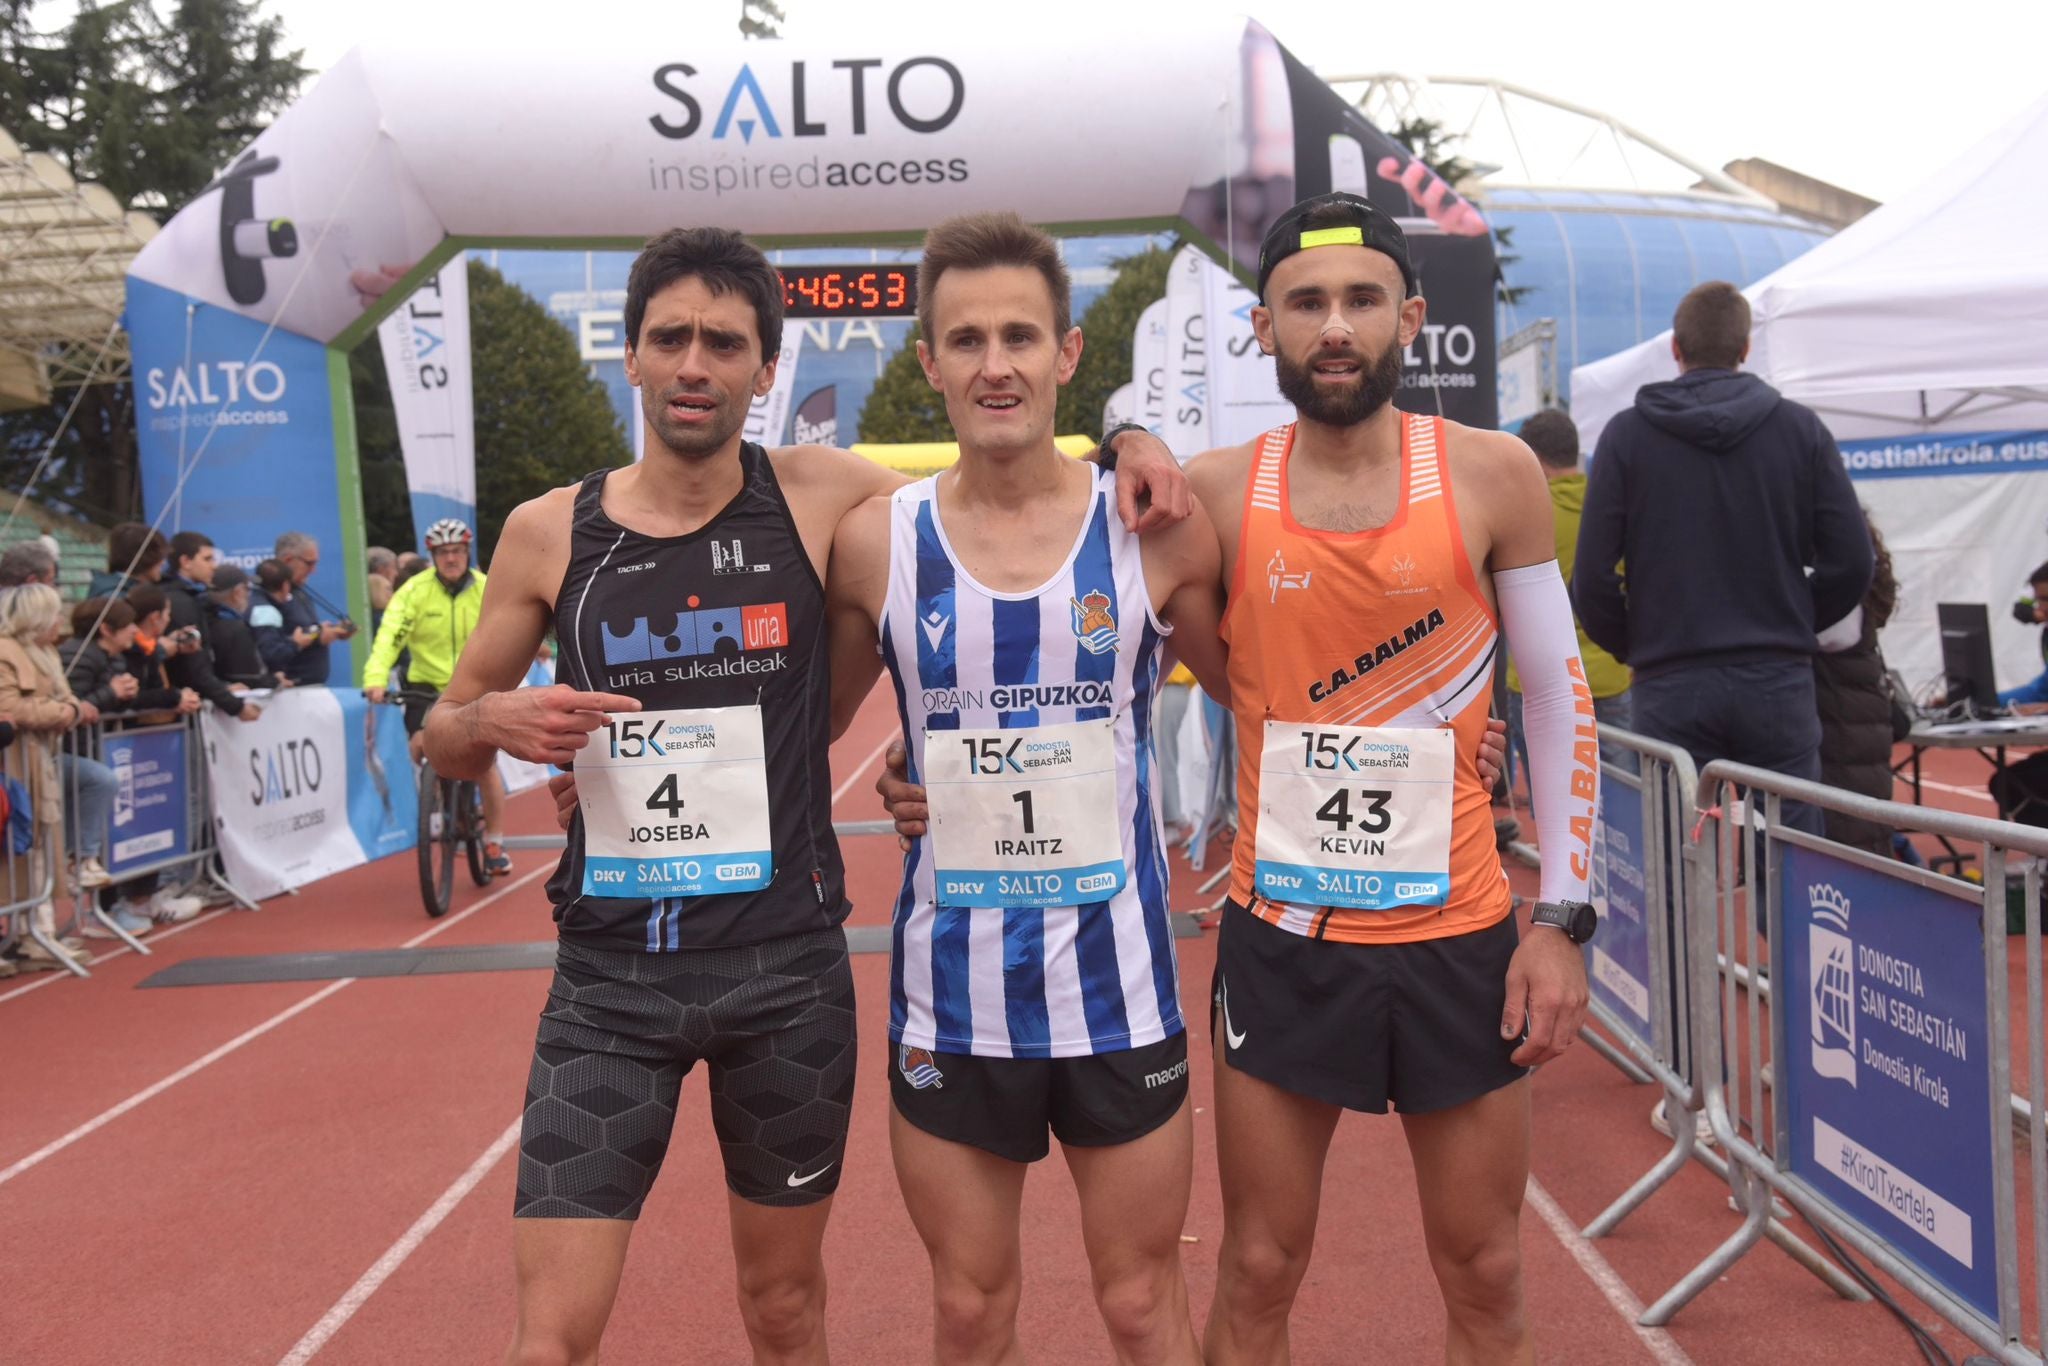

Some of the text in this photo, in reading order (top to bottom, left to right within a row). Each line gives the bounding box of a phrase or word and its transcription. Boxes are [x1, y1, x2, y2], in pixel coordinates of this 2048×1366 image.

[648, 56, 965, 145] SALTO
[776, 272, 906, 309] :46:53
[1403, 324, 1476, 367] LTO
[147, 361, 286, 410] SALTO
[609, 652, 788, 689] uria sukaldeak
[922, 681, 1114, 712] ORAIN GIPUZKOA
[668, 724, 715, 735] DONOSTIA
[696, 733, 715, 741] SAN
[665, 740, 716, 751] SEBASTIAN
[1026, 740, 1071, 753] DONOSTIA
[1054, 748, 1072, 758] SAN
[1364, 743, 1410, 753] DONOSTIA
[1023, 756, 1072, 768] SEBASTIAN
[1359, 758, 1409, 769] SEBASTIAN
[1390, 752, 1409, 761] SAN
[251, 737, 322, 807] SALTO
[645, 773, 685, 819] 4
[1012, 790, 1035, 834] 1
[1315, 788, 1392, 834] 43
[628, 823, 710, 843] JOSEBA
[995, 839, 1063, 856] IRAITZ
[1320, 836, 1385, 856] KEVIN
[593, 869, 627, 883] DKV
[638, 861, 700, 884] SALTO
[734, 866, 757, 877] BM
[1264, 873, 1303, 889] DKV
[946, 882, 985, 895] DKV
[998, 874, 1062, 896] SALTO
[1093, 877, 1113, 889] BM
[1316, 872, 1383, 895] SALTO
[1412, 886, 1434, 895] BM
[1859, 944, 1925, 998] DONOSTIA
[1860, 985, 1966, 1061] SAN SEBASTIÁN
[1863, 1038, 1949, 1109] Donostia Kirola
[1840, 1143, 1936, 1235] #KirolTxartela
